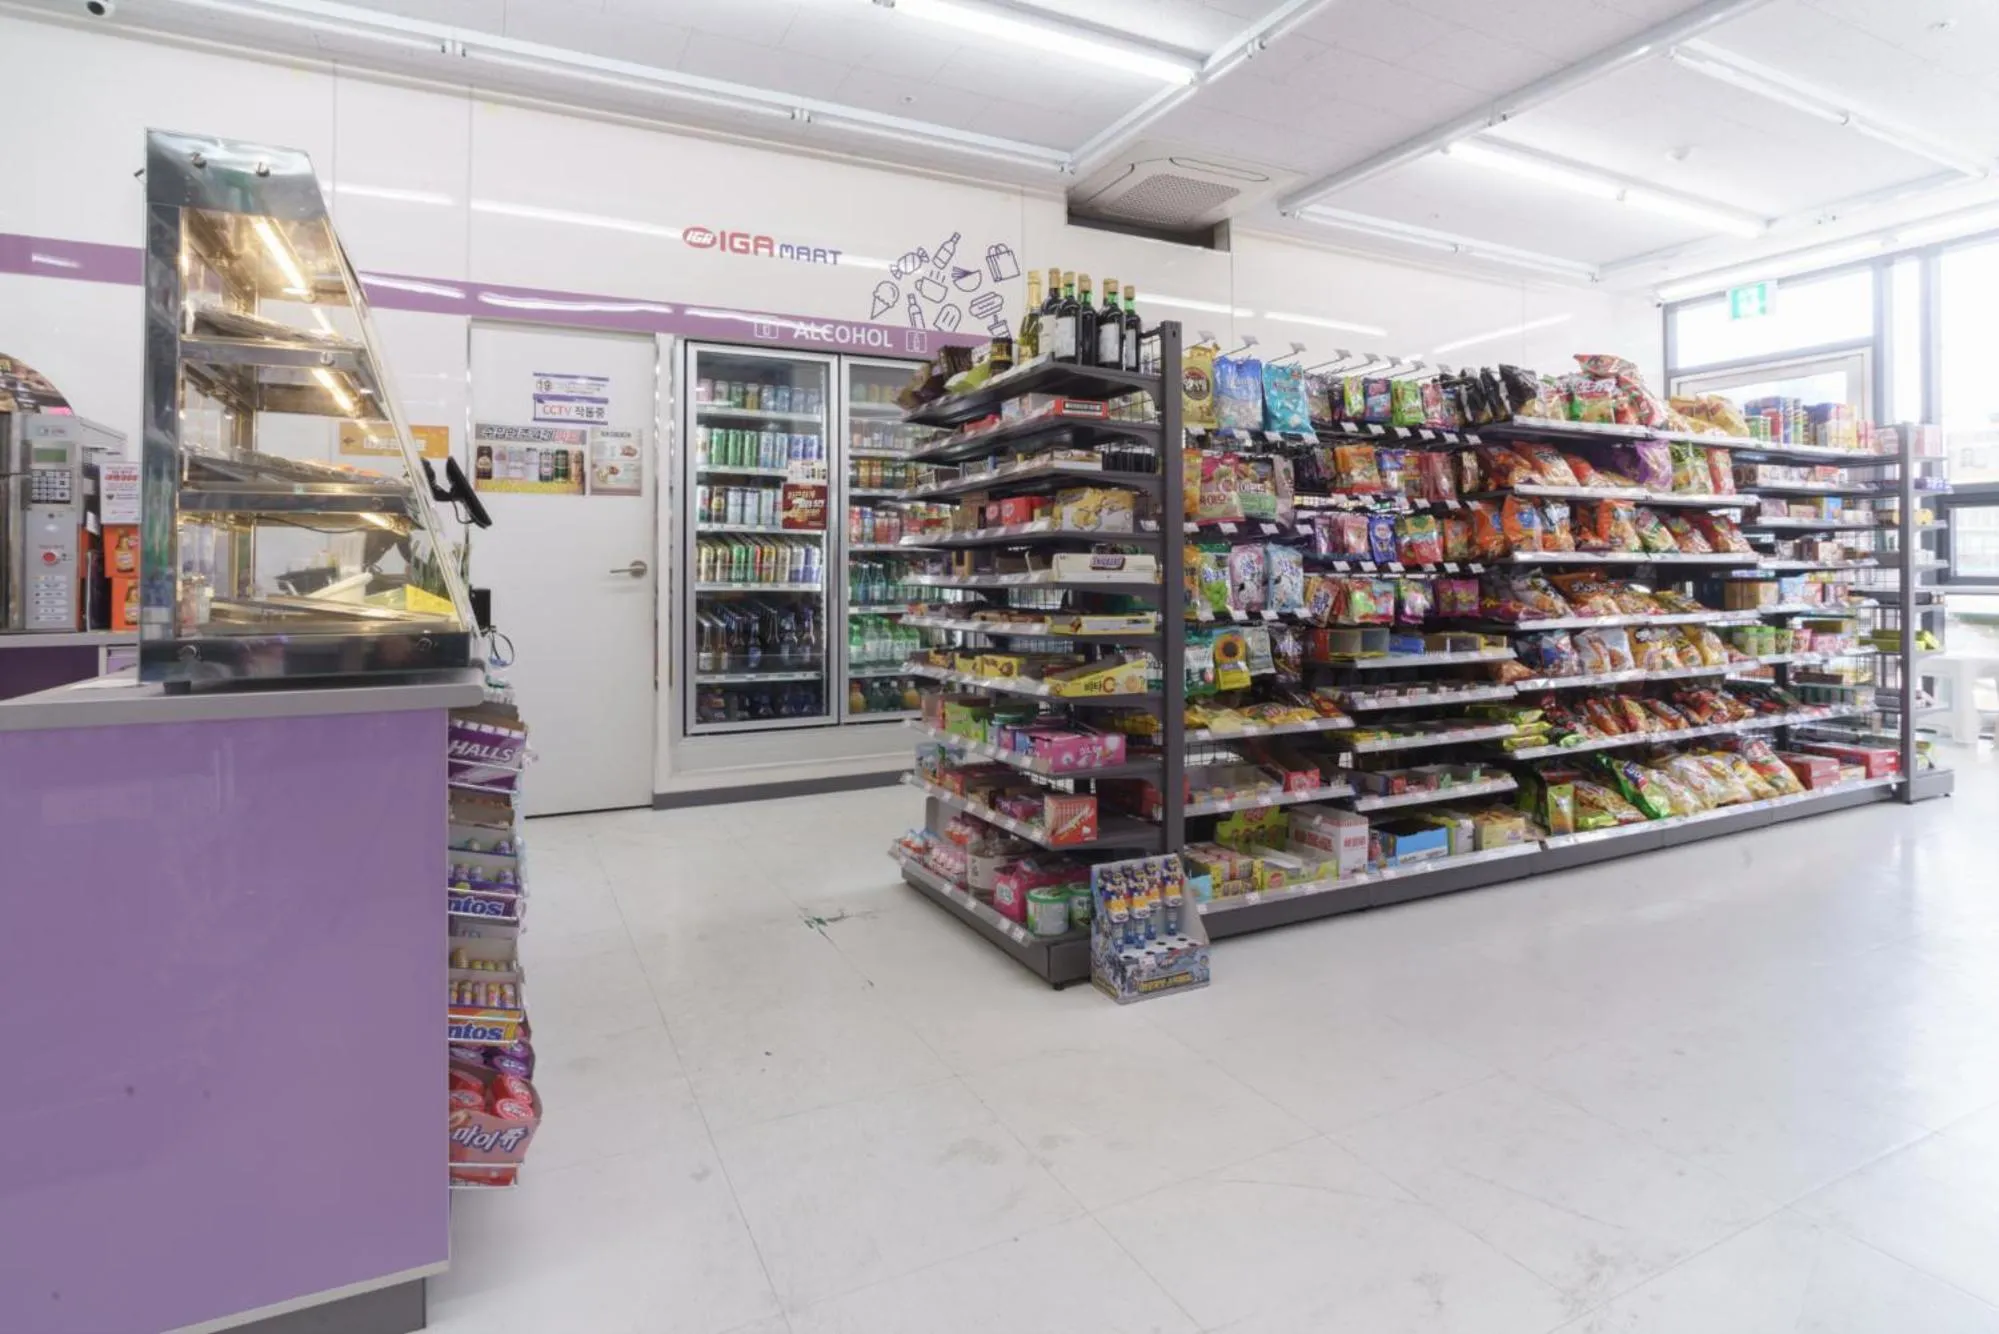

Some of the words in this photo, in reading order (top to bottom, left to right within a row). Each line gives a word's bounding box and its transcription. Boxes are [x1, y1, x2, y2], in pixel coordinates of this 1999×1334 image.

[686, 229, 714, 245] IGA
[719, 230, 775, 257] IGA
[779, 243, 842, 265] MART
[793, 321, 894, 348] ALCOHOL
[543, 404, 572, 416] CCTV
[574, 405, 605, 419] 작동중
[448, 739, 514, 762] HALLS
